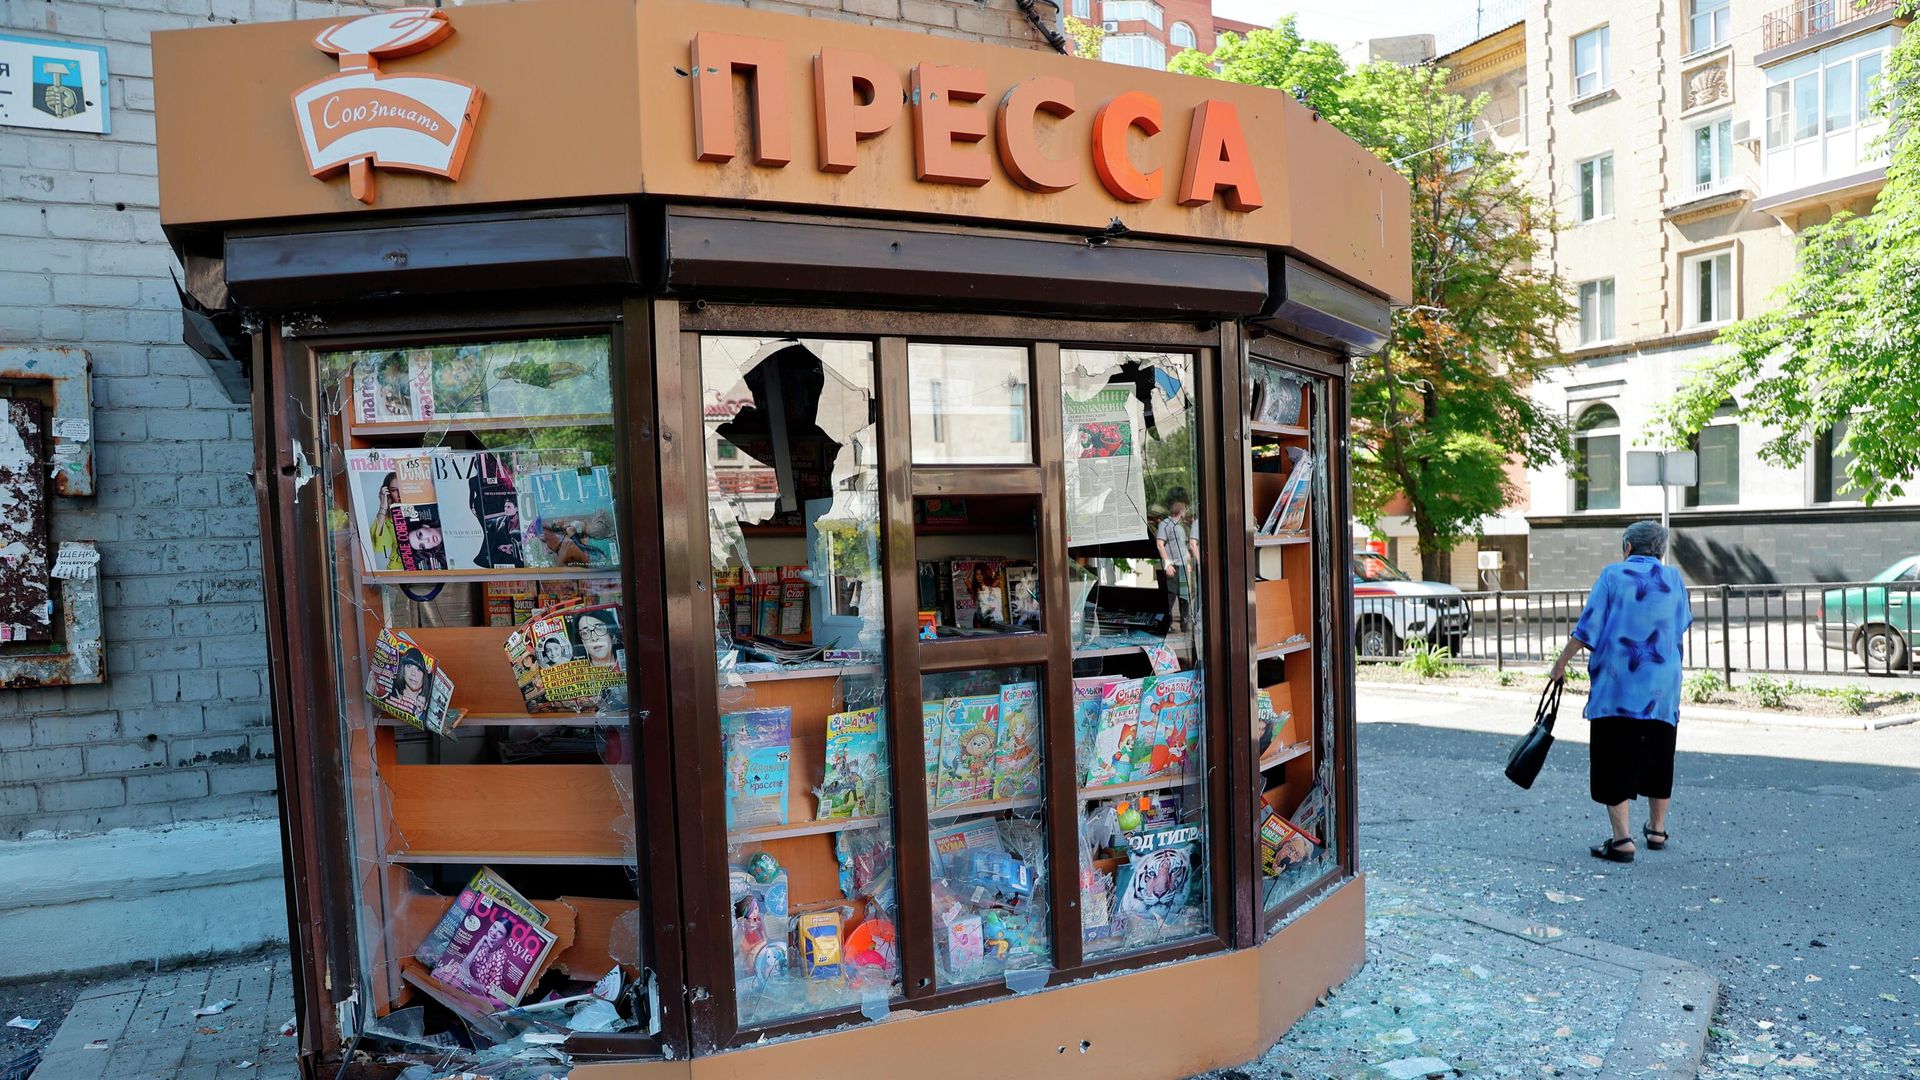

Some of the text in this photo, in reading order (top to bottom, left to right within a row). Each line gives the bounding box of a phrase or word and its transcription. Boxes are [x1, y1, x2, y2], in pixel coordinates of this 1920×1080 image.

[690, 31, 1264, 213] ПРЕССА
[406, 459, 419, 469] 135
[535, 468, 609, 503] ELLE
[392, 508, 409, 541] СОВЕТЫ
[542, 660, 588, 675] ОНА ПЕРЕЖИЛА
[550, 670, 575, 682] ДЕТСТВЕ
[551, 676, 585, 688] МЕРЗКИМИ
[554, 685, 576, 695] ТЕПЕРЬ
[1129, 827, 1201, 852] ОД ТИГР
[473, 893, 541, 956] buda
[506, 937, 533, 965] style
